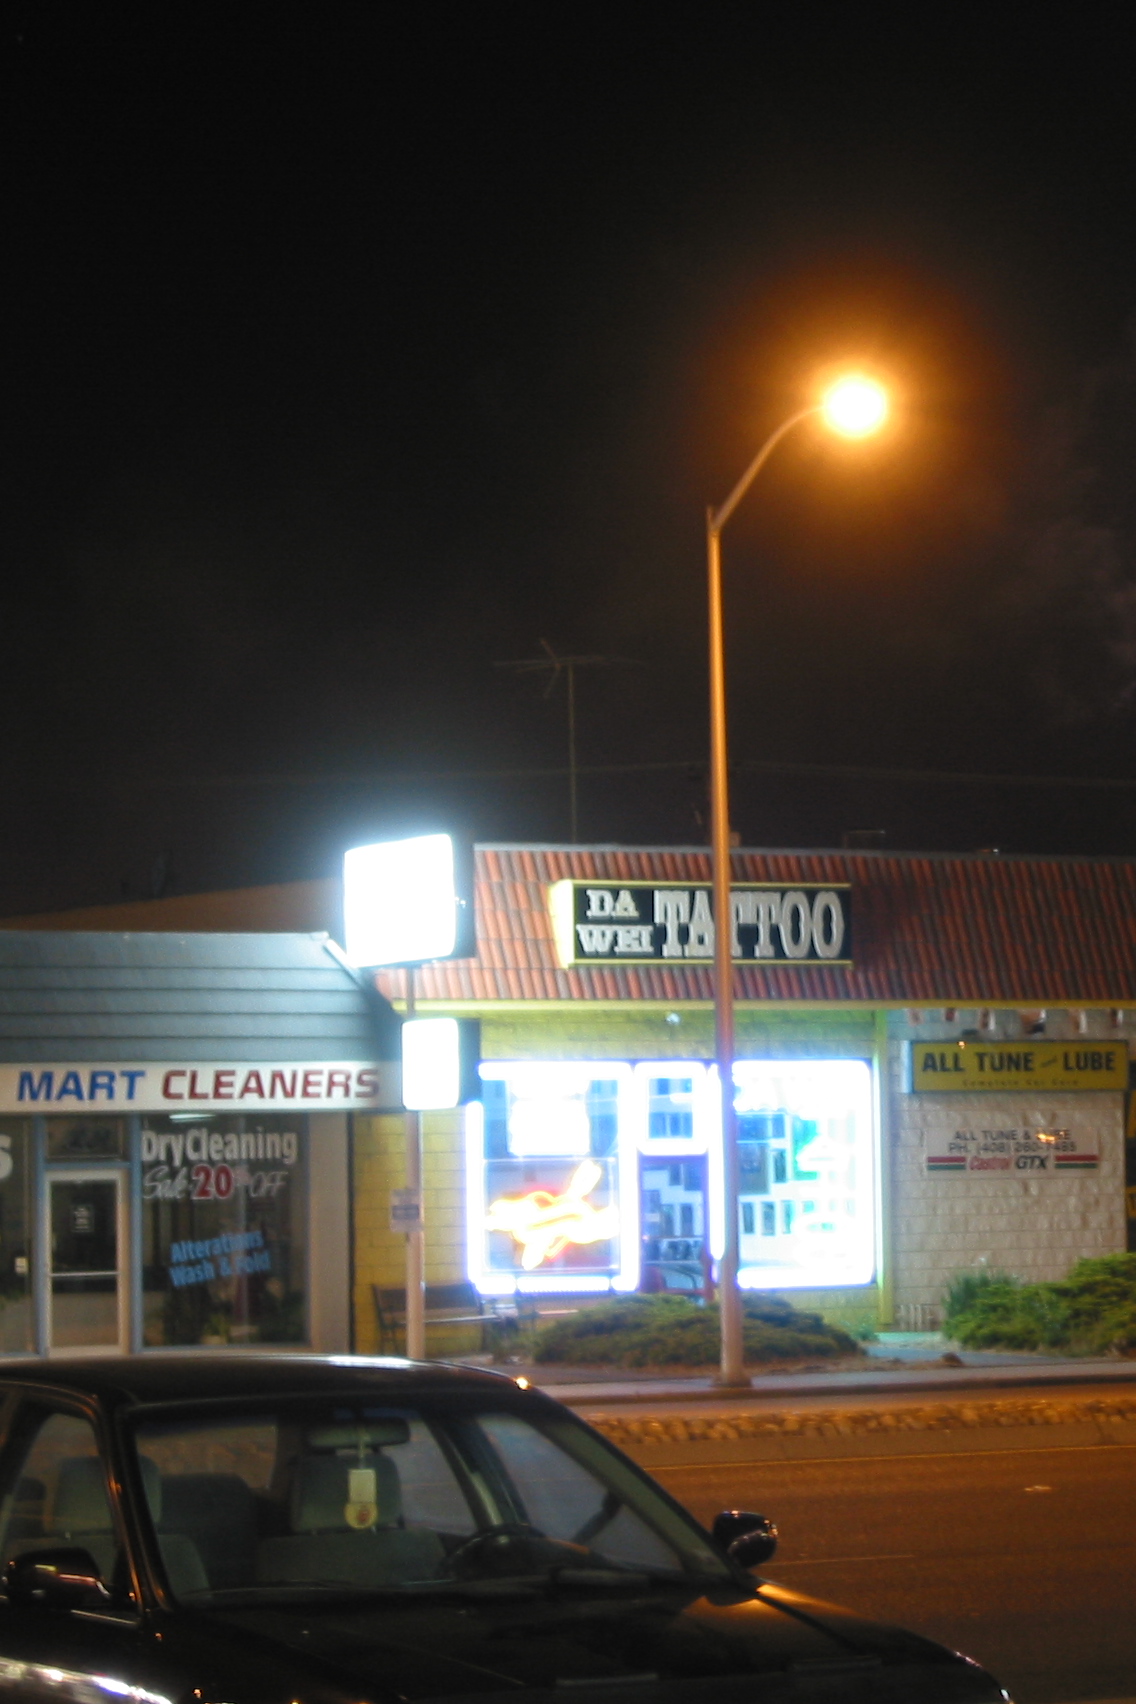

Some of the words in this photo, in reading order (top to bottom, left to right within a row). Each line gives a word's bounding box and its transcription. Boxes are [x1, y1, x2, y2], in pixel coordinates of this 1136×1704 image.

[586, 889, 640, 918] DA
[653, 889, 845, 959] TATTOO
[577, 924, 654, 956] WEI
[922, 1052, 965, 1072] ALL
[976, 1051, 1035, 1071] TUNE
[1063, 1050, 1116, 1071] LUBE
[18, 1069, 146, 1101] MART
[162, 1068, 380, 1101] CLEANERS
[954, 1130, 977, 1141] ALL
[982, 1129, 1018, 1140] TUNE
[1015, 1154, 1049, 1170] GTX
